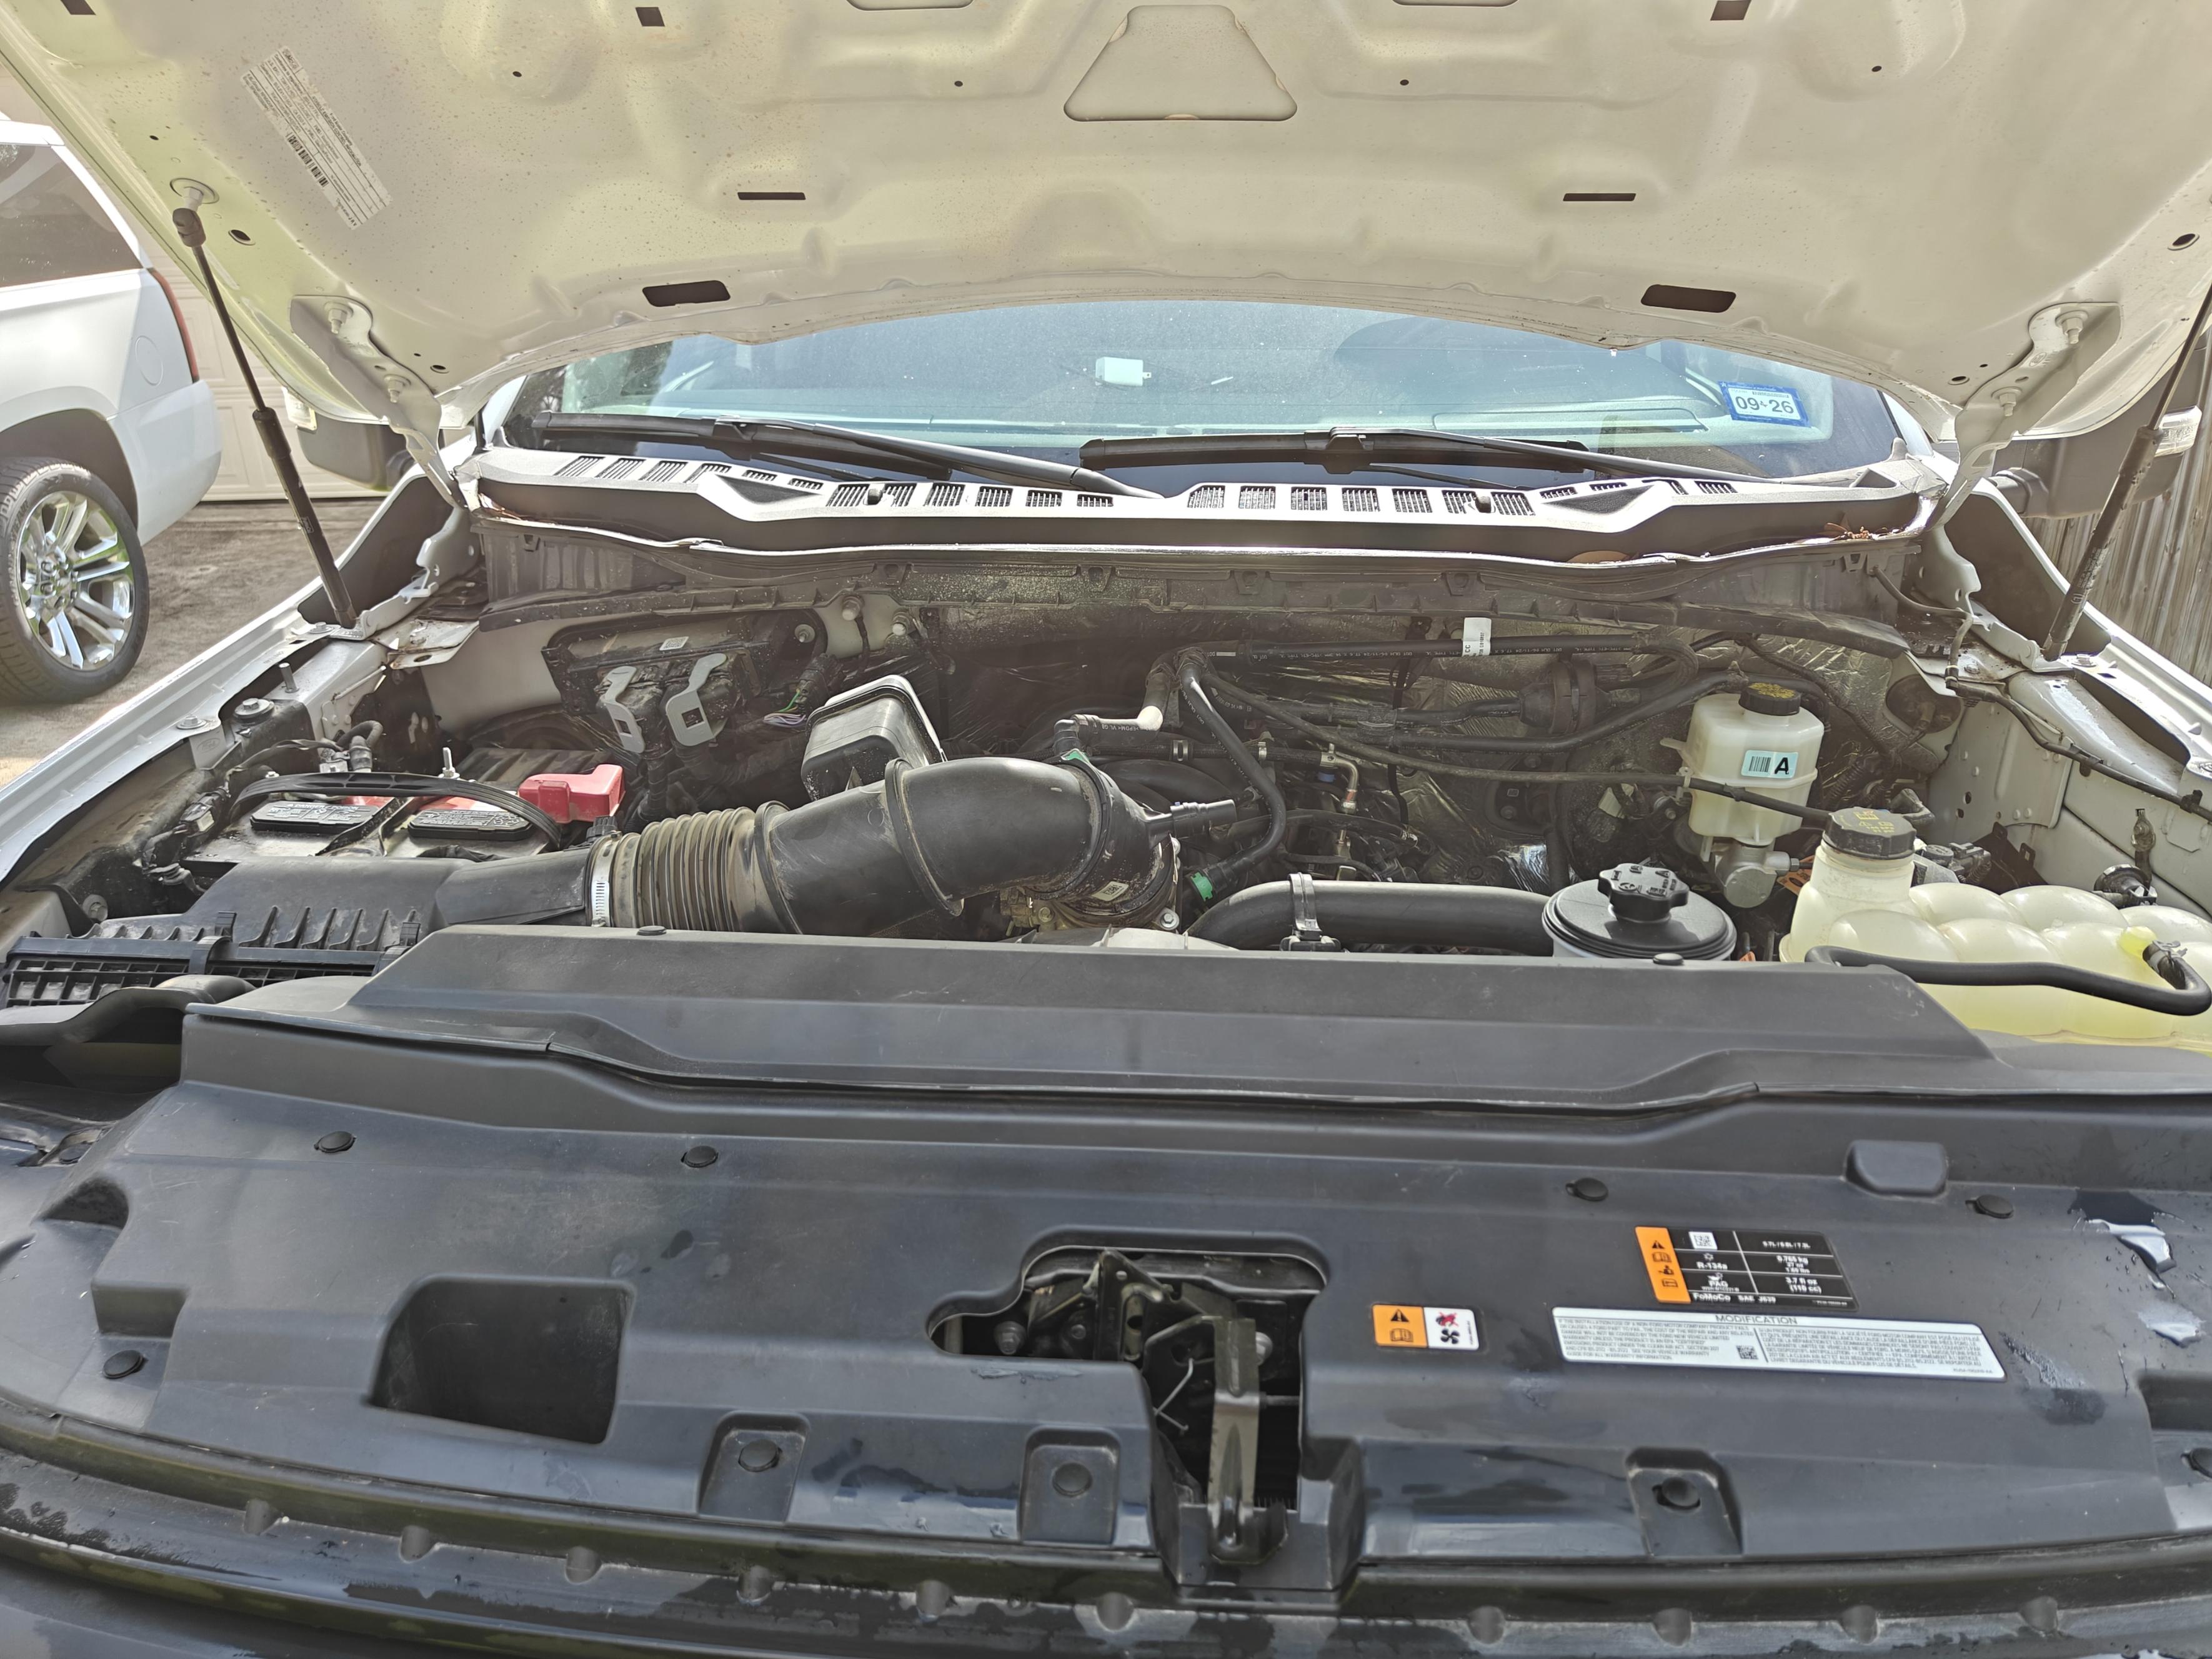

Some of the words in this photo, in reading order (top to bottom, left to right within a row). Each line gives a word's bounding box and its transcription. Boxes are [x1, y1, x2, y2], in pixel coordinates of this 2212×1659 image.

[1735, 396, 1760, 411] 09
[1768, 399, 1795, 414] 26
[1774, 756, 1790, 775] A
[1693, 1292, 1731, 1303] FoMoCo
[1715, 1314, 1798, 1325] MODIFICATION
